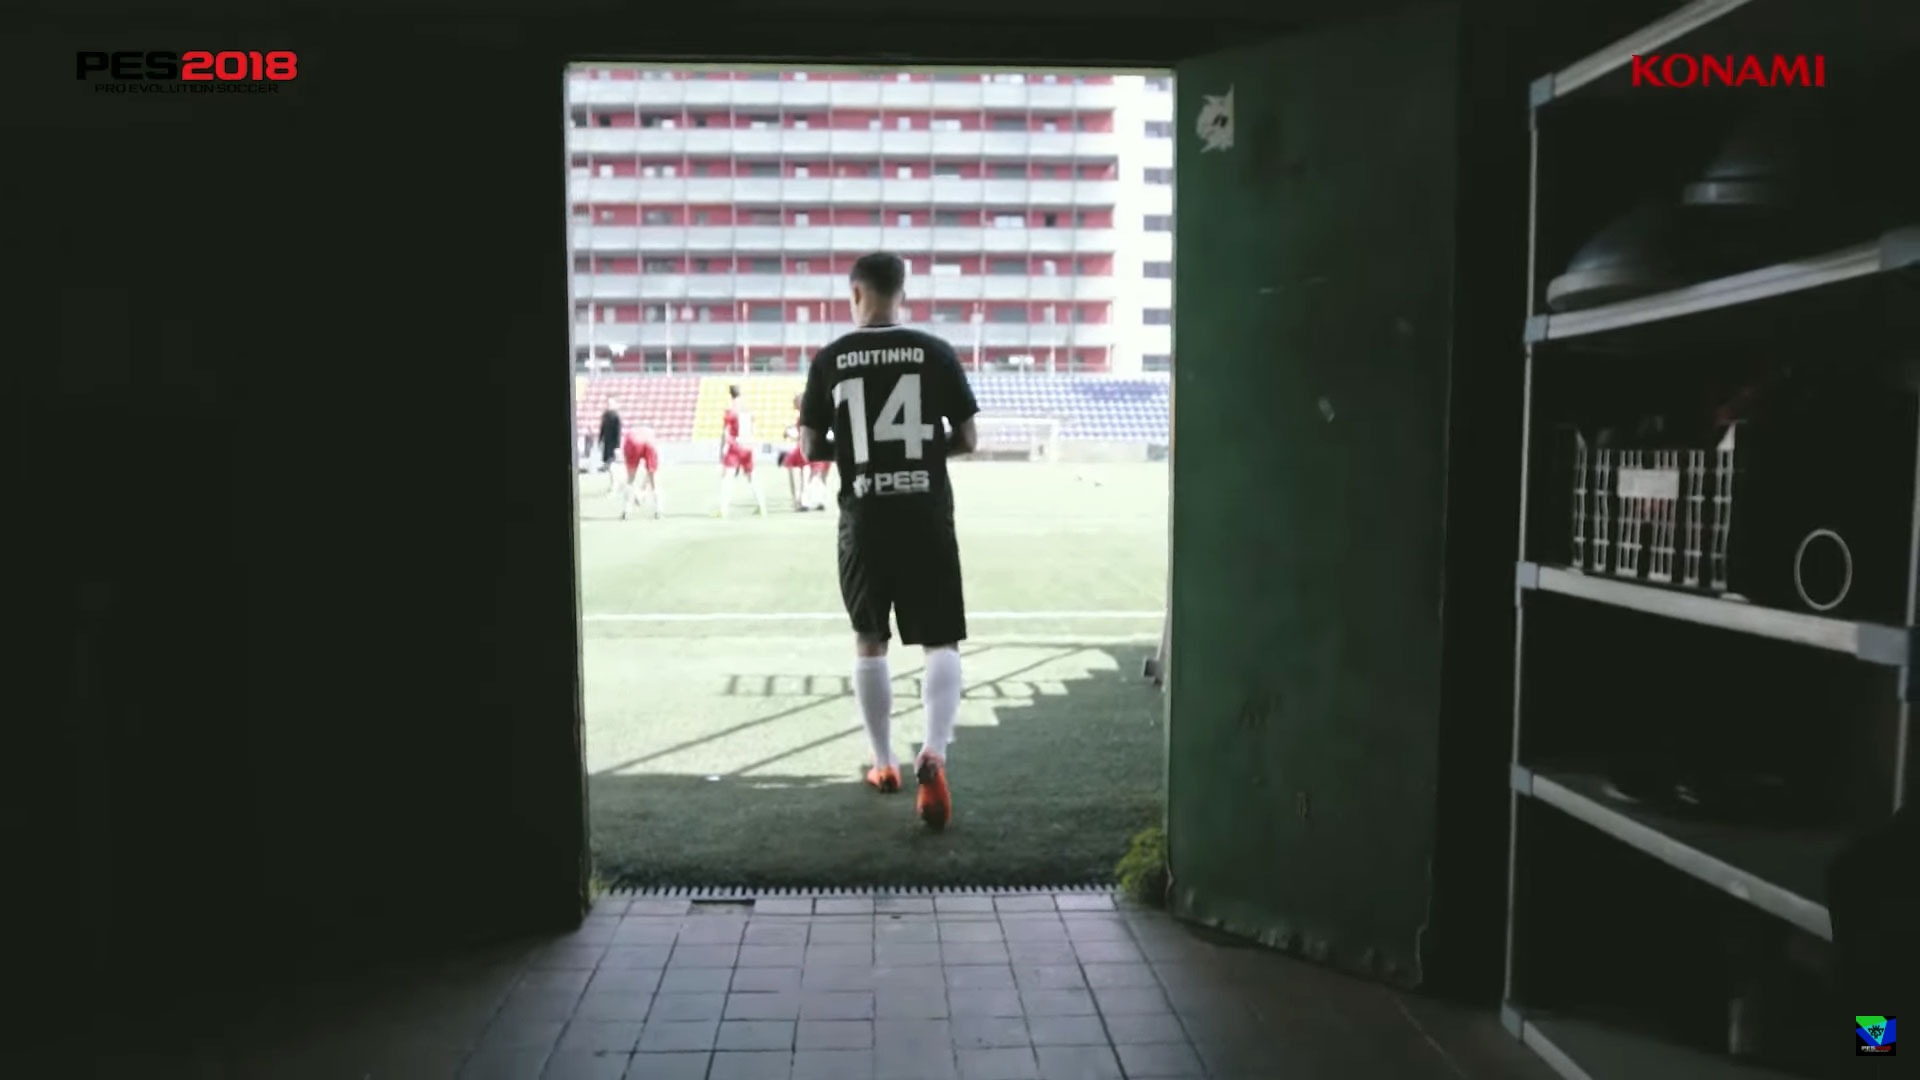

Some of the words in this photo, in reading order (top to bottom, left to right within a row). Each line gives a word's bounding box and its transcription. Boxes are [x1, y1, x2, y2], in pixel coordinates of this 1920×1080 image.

[836, 347, 925, 370] COUTINHO
[832, 373, 935, 465] 14
[874, 470, 930, 490] PES
